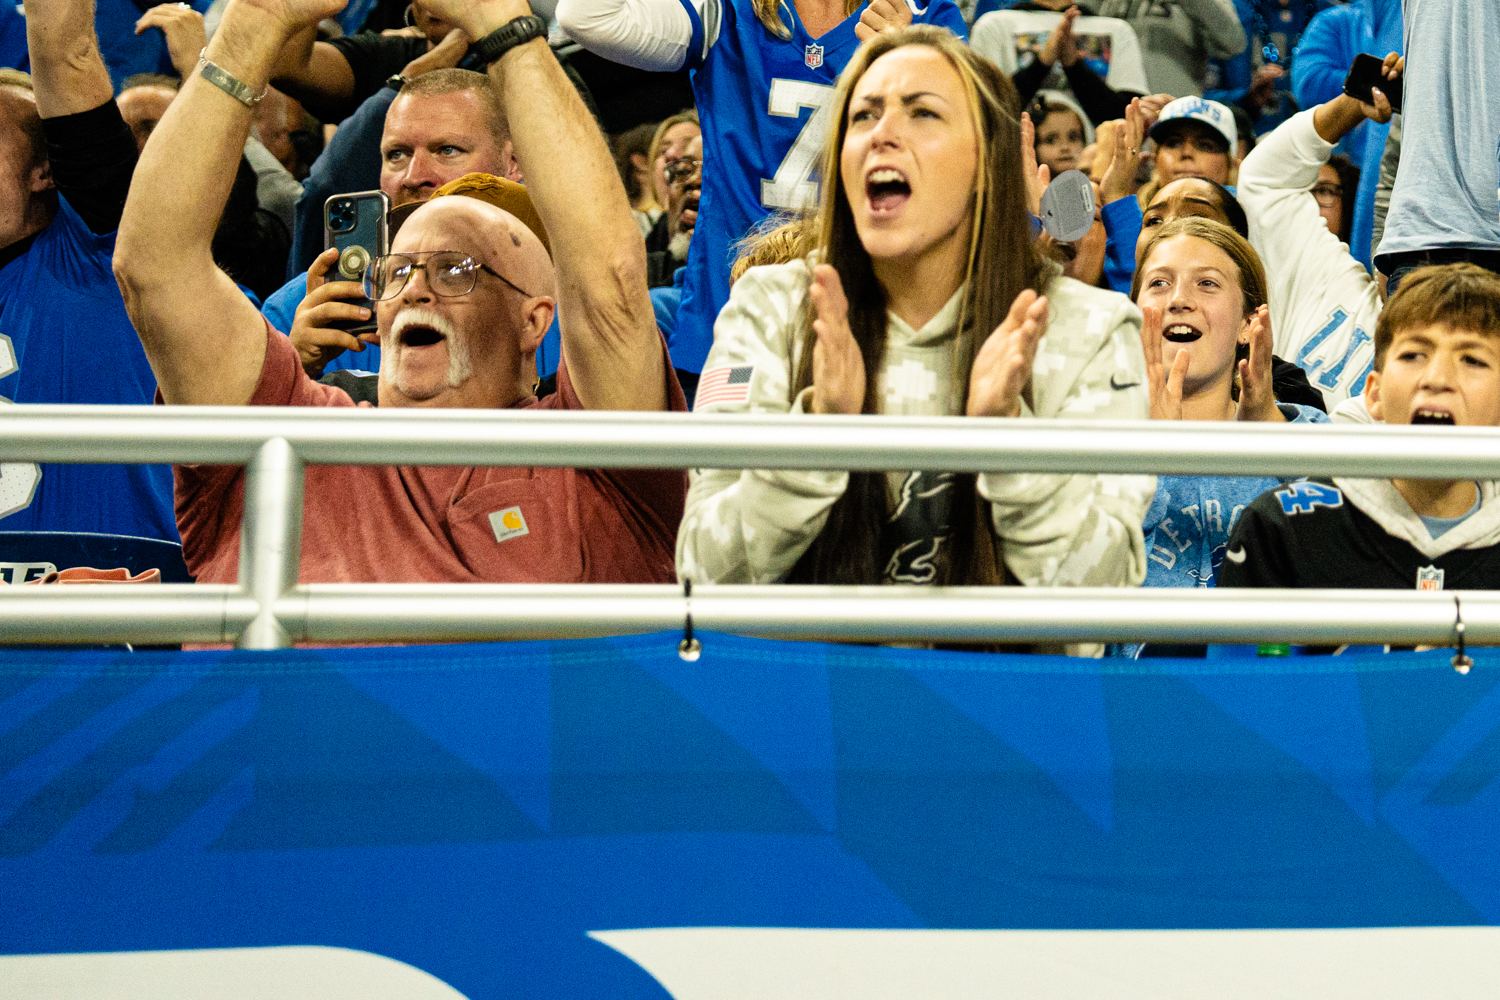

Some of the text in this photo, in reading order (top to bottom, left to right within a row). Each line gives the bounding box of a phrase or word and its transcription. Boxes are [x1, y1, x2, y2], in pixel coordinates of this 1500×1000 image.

[807, 53, 823, 66] NFL
[760, 77, 839, 209] 7
[1274, 480, 1344, 517] 4
